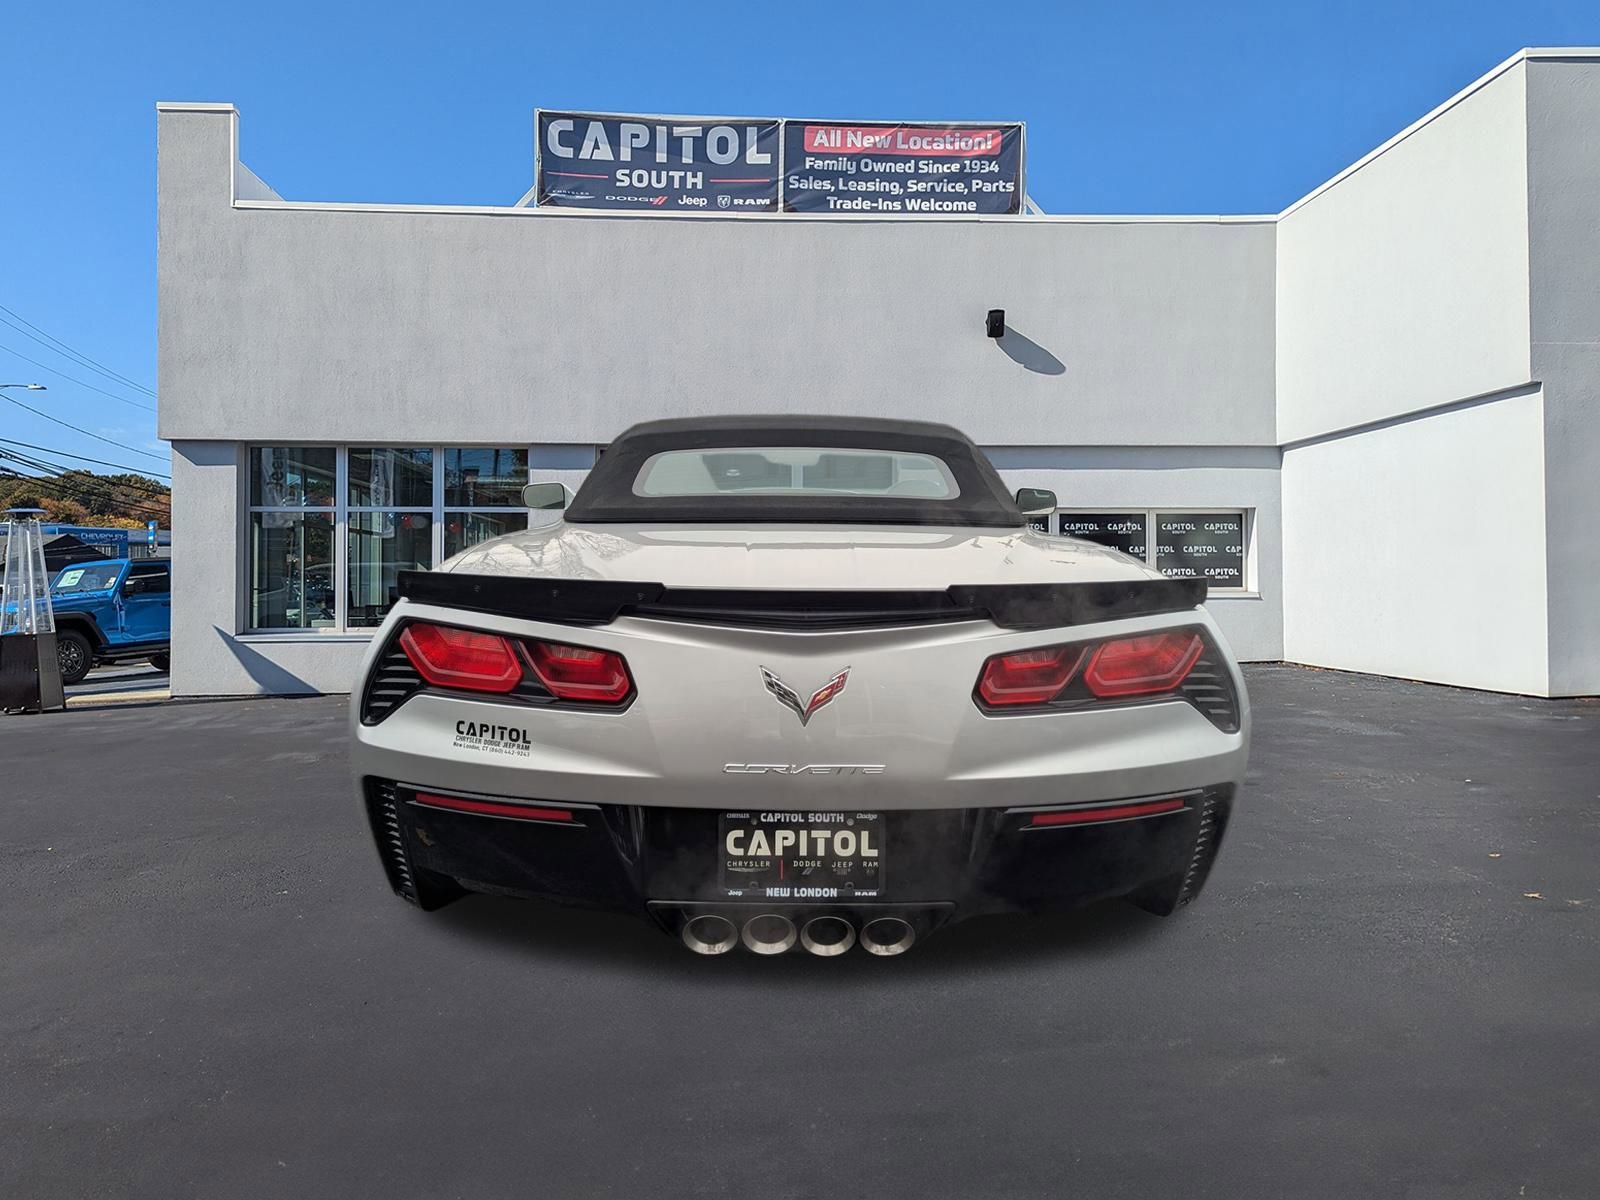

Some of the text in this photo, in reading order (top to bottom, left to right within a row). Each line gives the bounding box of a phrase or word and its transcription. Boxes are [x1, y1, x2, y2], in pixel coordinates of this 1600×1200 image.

[547, 119, 771, 165] CAPITOL
[813, 130, 993, 150] All New Location!
[805, 157, 1000, 174] Family Owned Since 1934
[615, 169, 703, 189] SOUTH
[789, 176, 1015, 195] Sales, Leasing, Service, Parts
[678, 195, 708, 207] Jeep
[826, 196, 977, 211] Trade-Ins Welcome
[1107, 522, 1142, 531] CAPITOL
[456, 720, 531, 745] CAPITOL
[516, 743, 530, 751] RAM
[722, 763, 887, 774] CORVETTE
[760, 813, 844, 823] CAPITOL SOUTH
[726, 830, 879, 857] CAPITOL
[766, 887, 838, 897] NEW LONDON
